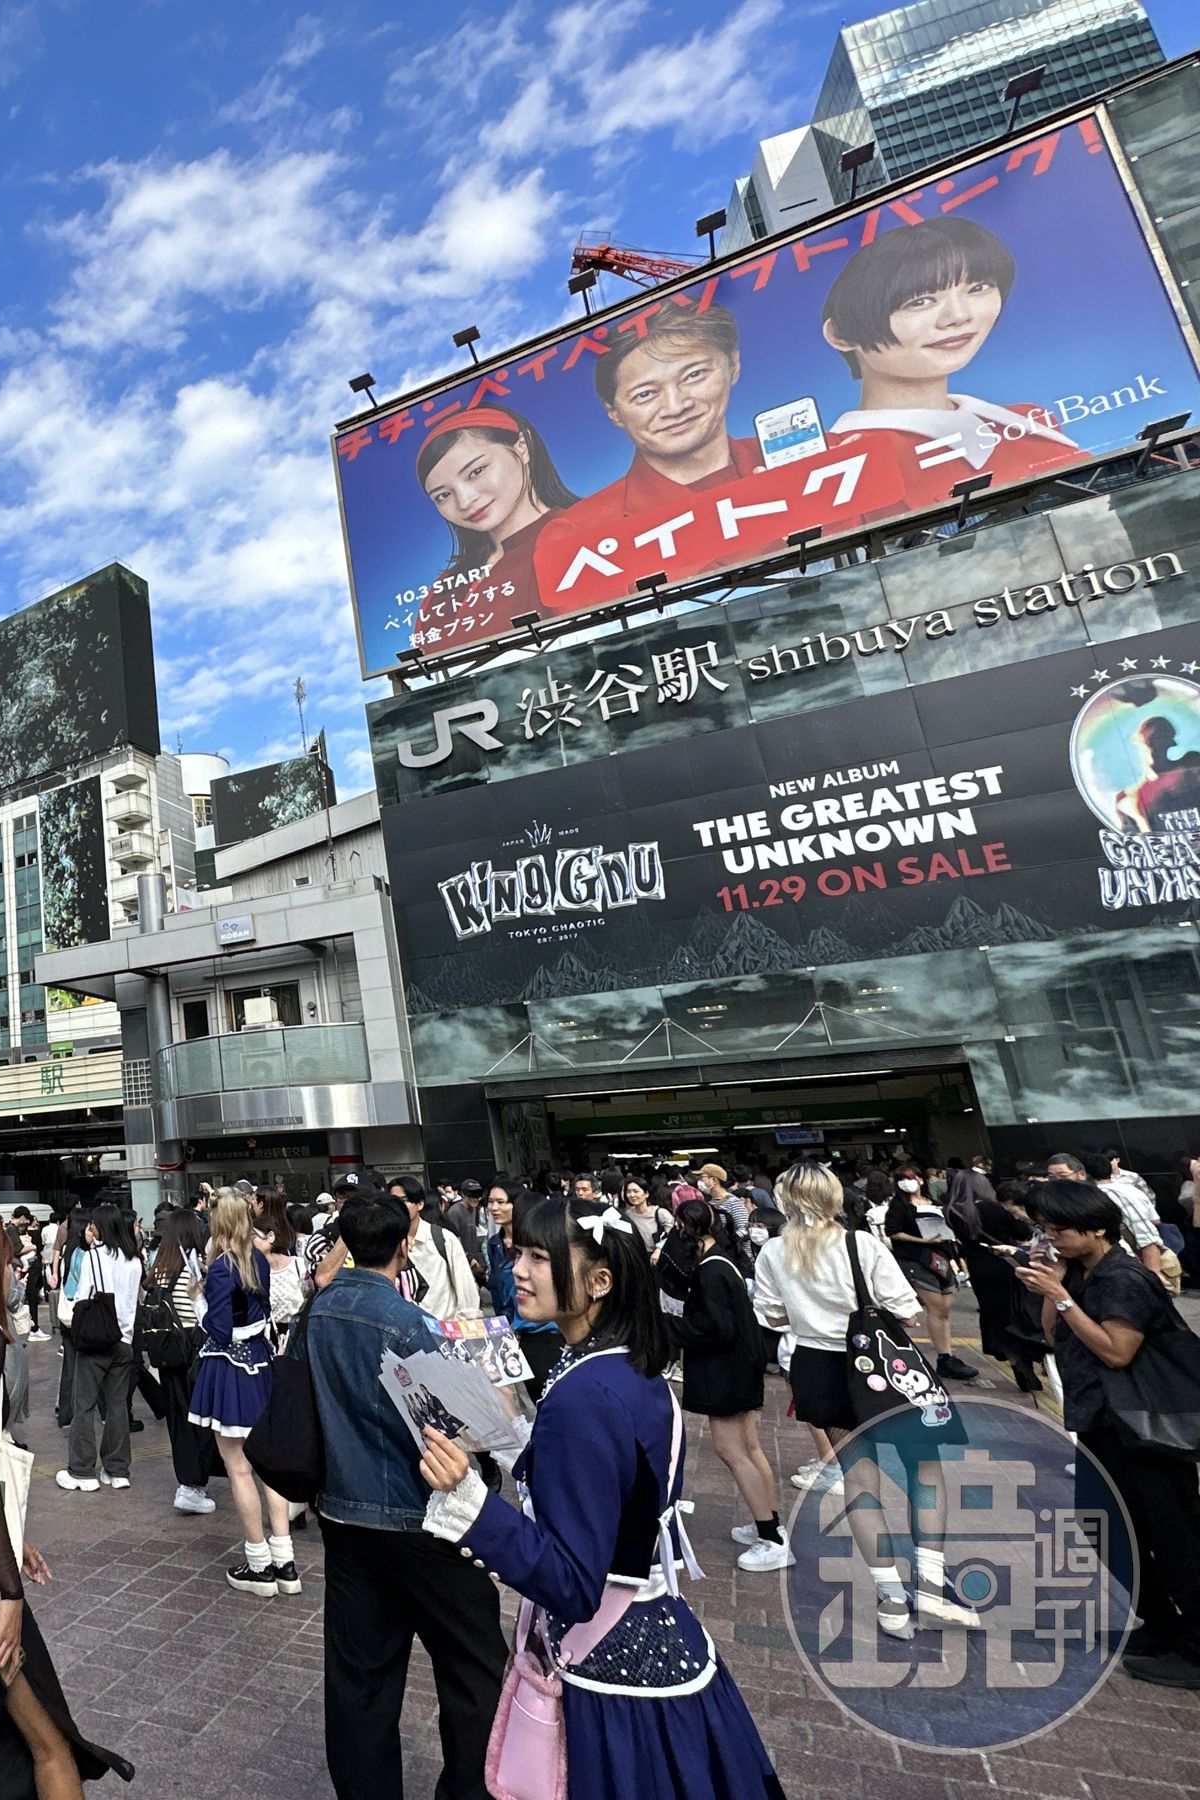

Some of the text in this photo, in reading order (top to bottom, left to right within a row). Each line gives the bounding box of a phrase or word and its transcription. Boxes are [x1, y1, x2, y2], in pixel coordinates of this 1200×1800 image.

[976, 374, 1168, 450] SoftBank
[555, 453, 871, 593] ペイトク
[383, 579, 516, 632] ペイしてトクする
[395, 563, 493, 606] 10.3 START
[397, 550, 1190, 769] JR 渋谷駅 shibuya station
[408, 611, 495, 649] 料金プラン
[692, 765, 1004, 848] THE GREATEST
[768, 760, 901, 799] NEW ALBUM
[501, 826, 580, 848] JAPAN MADE
[721, 807, 978, 875] UNKNOWN
[716, 841, 1013, 913] 11.29 ON SALE
[507, 917, 607, 940] TOKYO CHAOTIC
